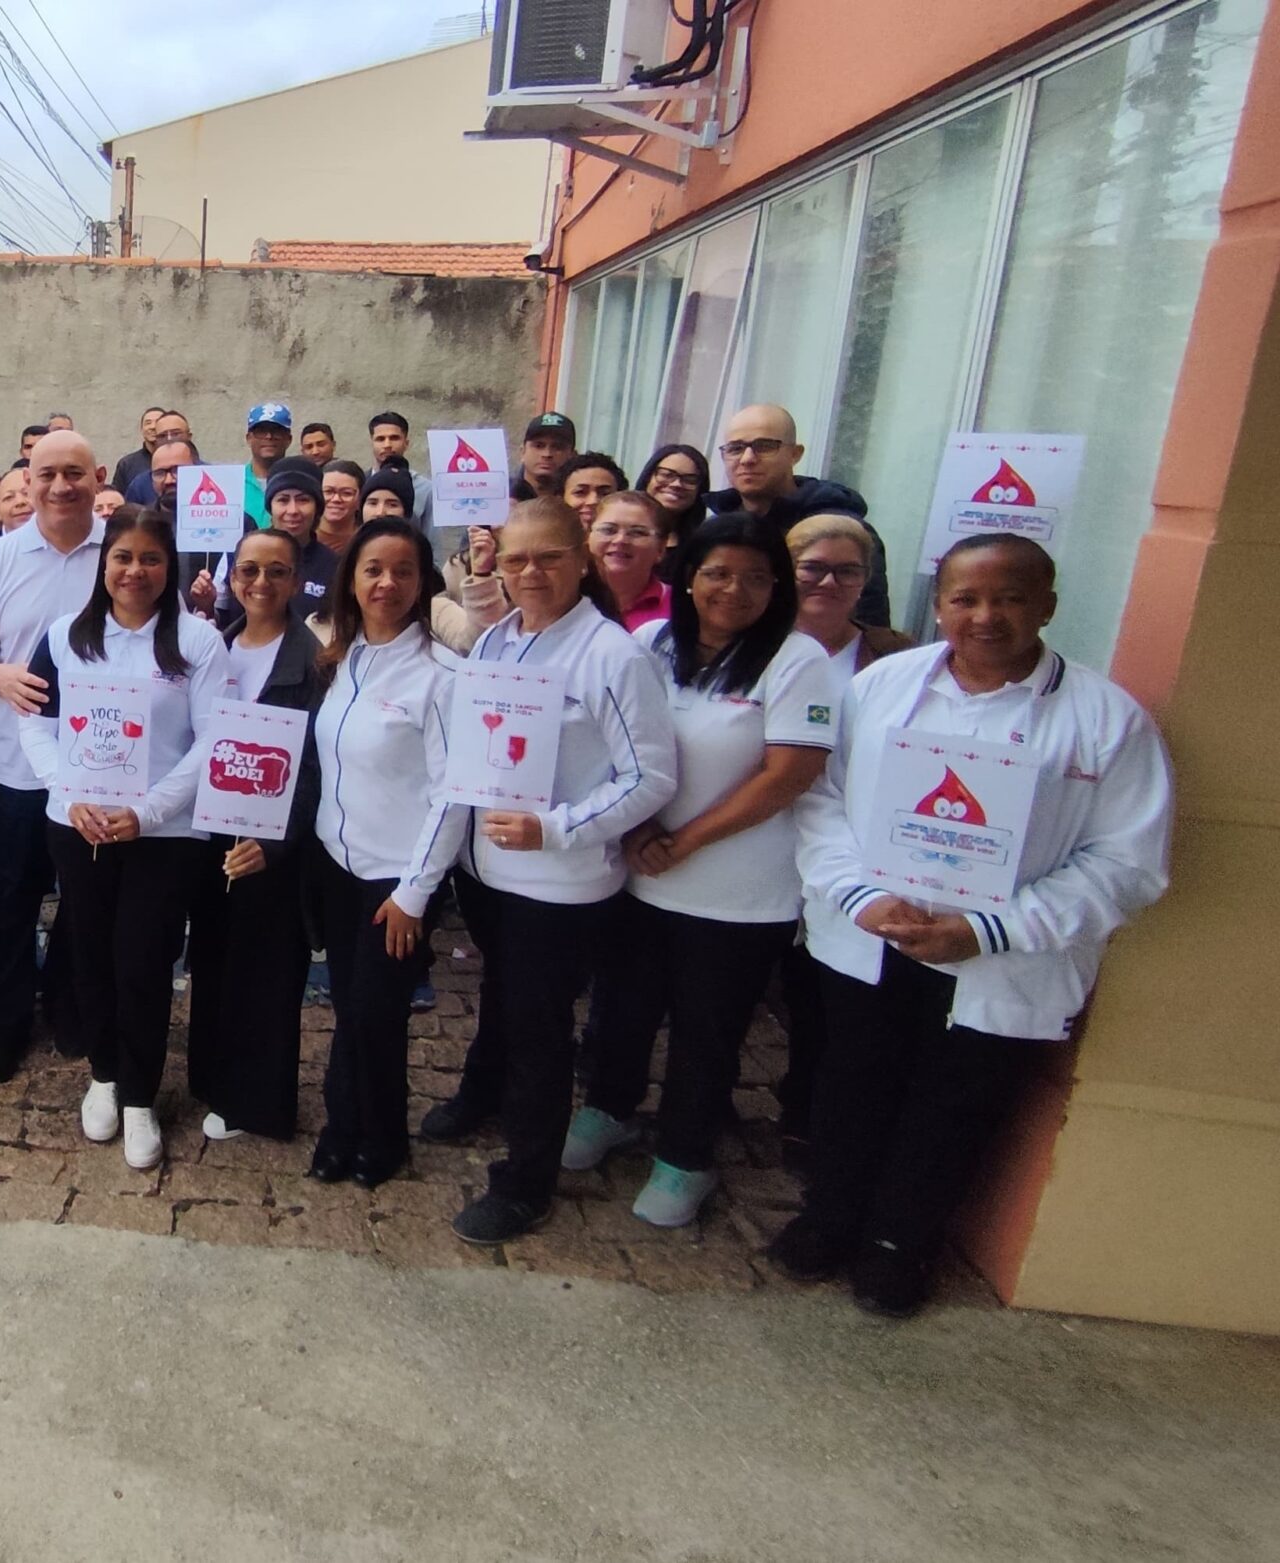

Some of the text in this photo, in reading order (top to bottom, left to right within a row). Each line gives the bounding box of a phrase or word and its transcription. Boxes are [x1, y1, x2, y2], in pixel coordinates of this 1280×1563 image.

[191, 509, 229, 517] EU DOEI
[515, 703, 543, 711] SANGUE
[213, 741, 258, 767] #EU
[224, 764, 265, 781] DOEI
